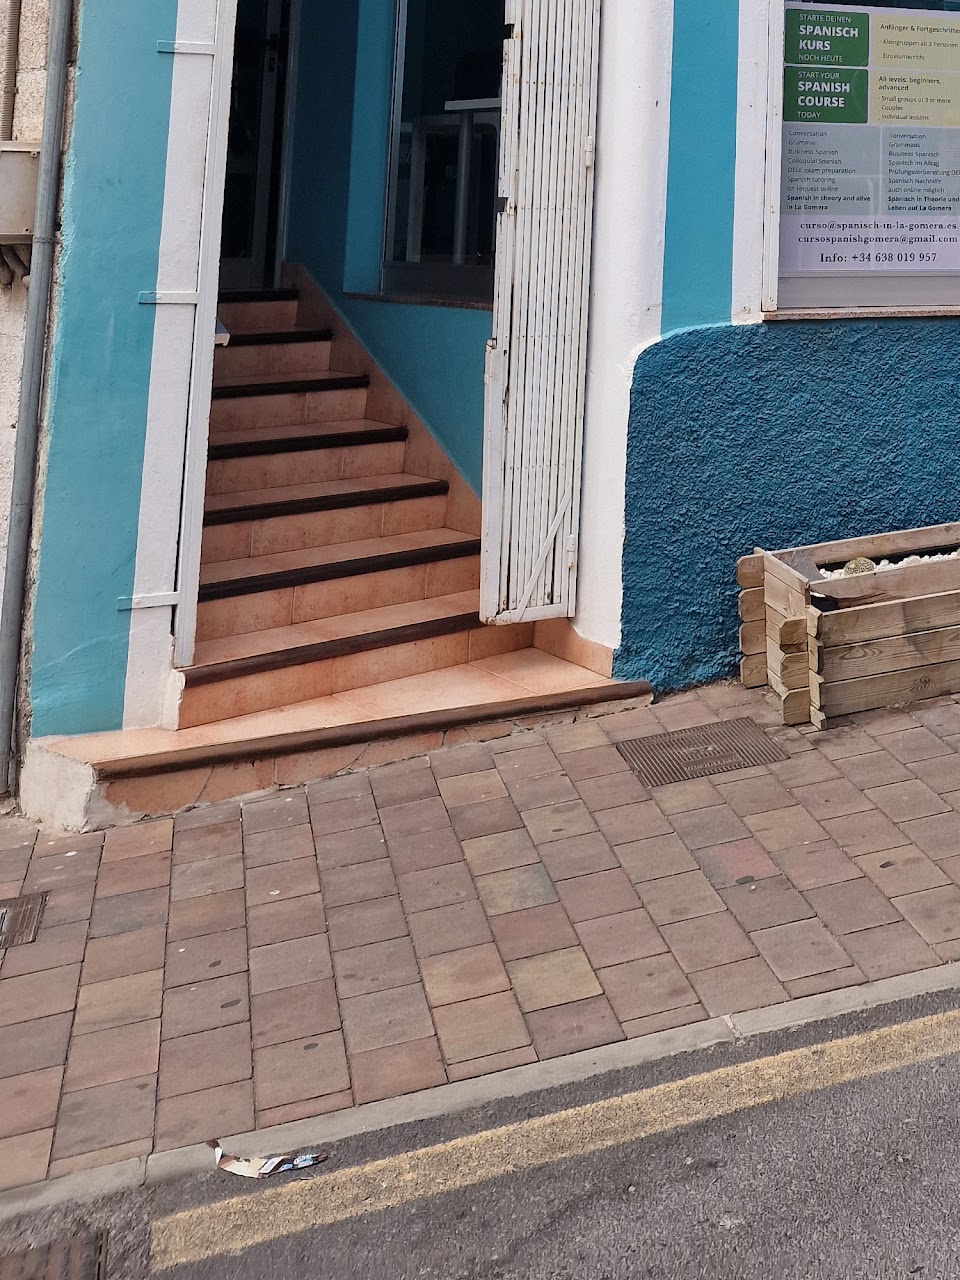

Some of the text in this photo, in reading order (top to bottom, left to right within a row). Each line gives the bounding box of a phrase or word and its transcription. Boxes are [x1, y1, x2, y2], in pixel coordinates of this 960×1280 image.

[825, 15, 851, 23] DEINEN
[799, 25, 859, 38] SPANISCH
[799, 39, 831, 51] KURS
[820, 72, 839, 80] YOUR
[798, 81, 850, 93] SPANISH
[797, 96, 845, 108] COURSE
[797, 111, 820, 119] TODAY
[800, 221, 957, 231] curso@spanisch-in-la-gomera.es
[798, 235, 958, 244] cursospanishgomera@gmail.com
[820, 253, 937, 263] Info: +34 638 019 957
